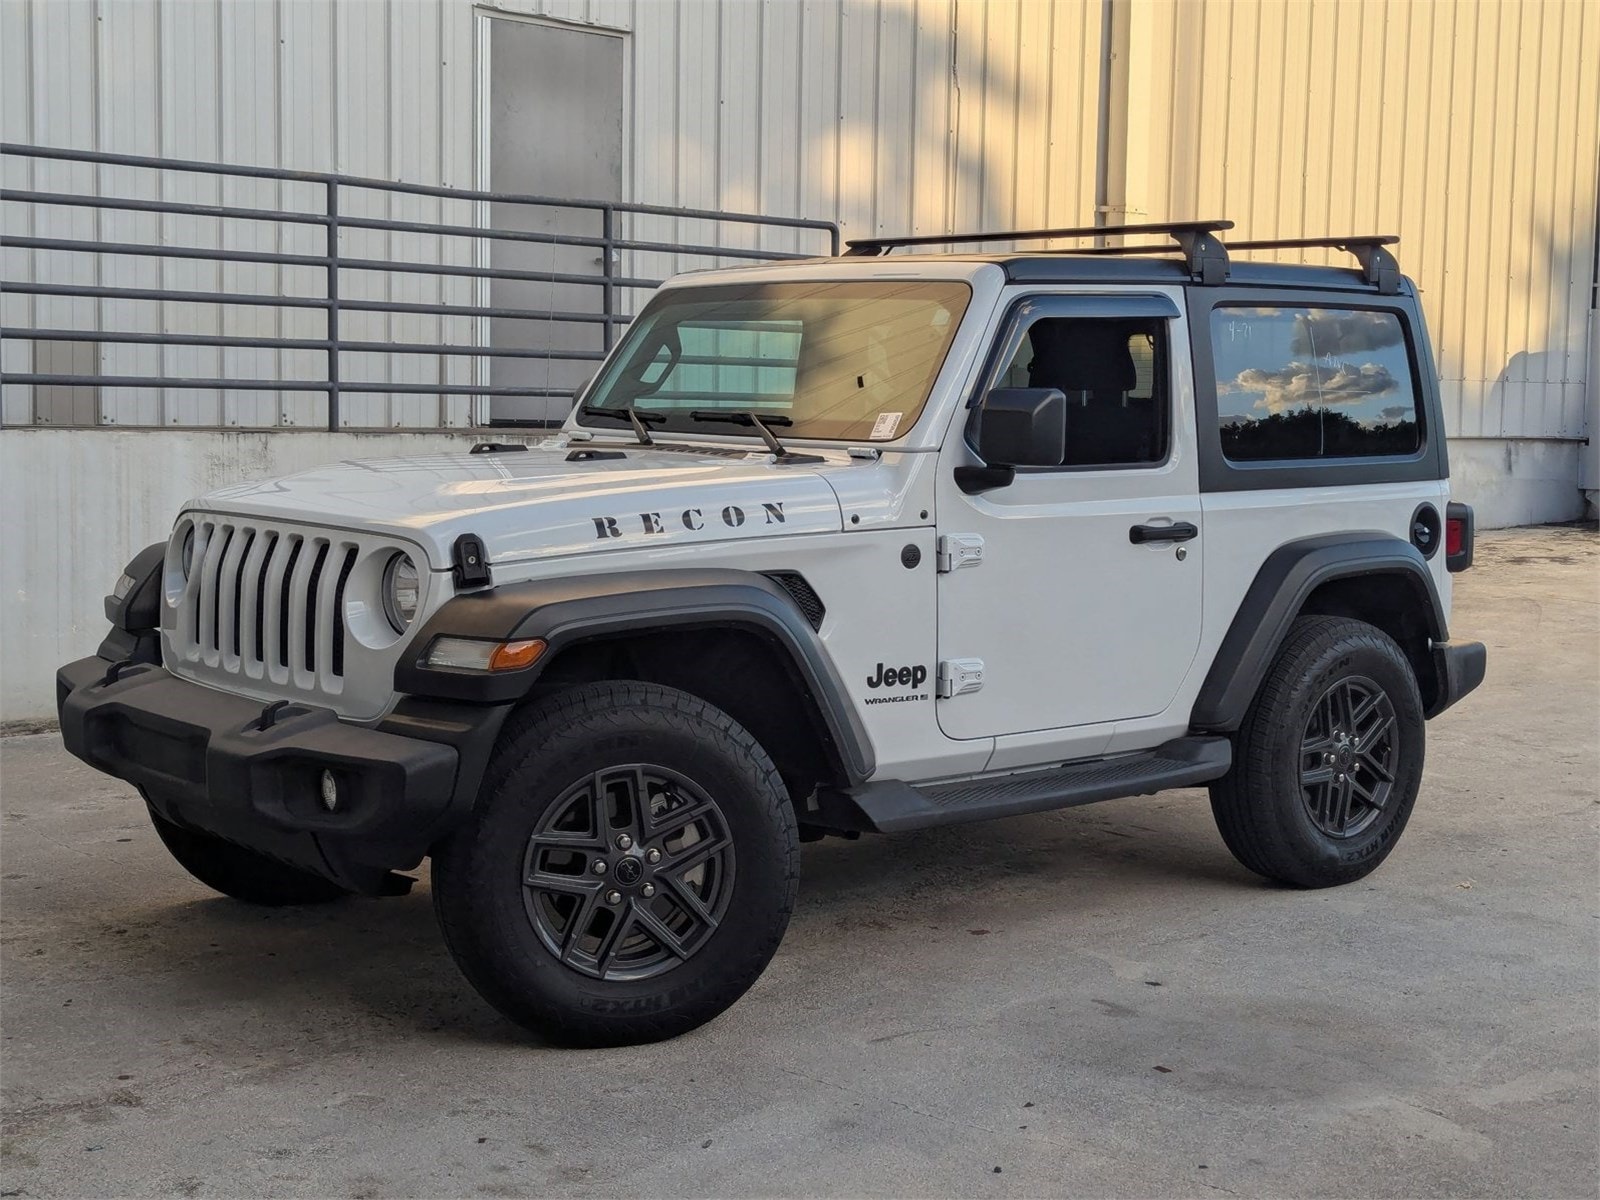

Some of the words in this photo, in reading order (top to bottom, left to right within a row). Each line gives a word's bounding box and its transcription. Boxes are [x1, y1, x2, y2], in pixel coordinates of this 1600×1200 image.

[592, 502, 786, 539] RECON
[867, 663, 927, 689] Jeep
[864, 695, 919, 705] WRANGLER
